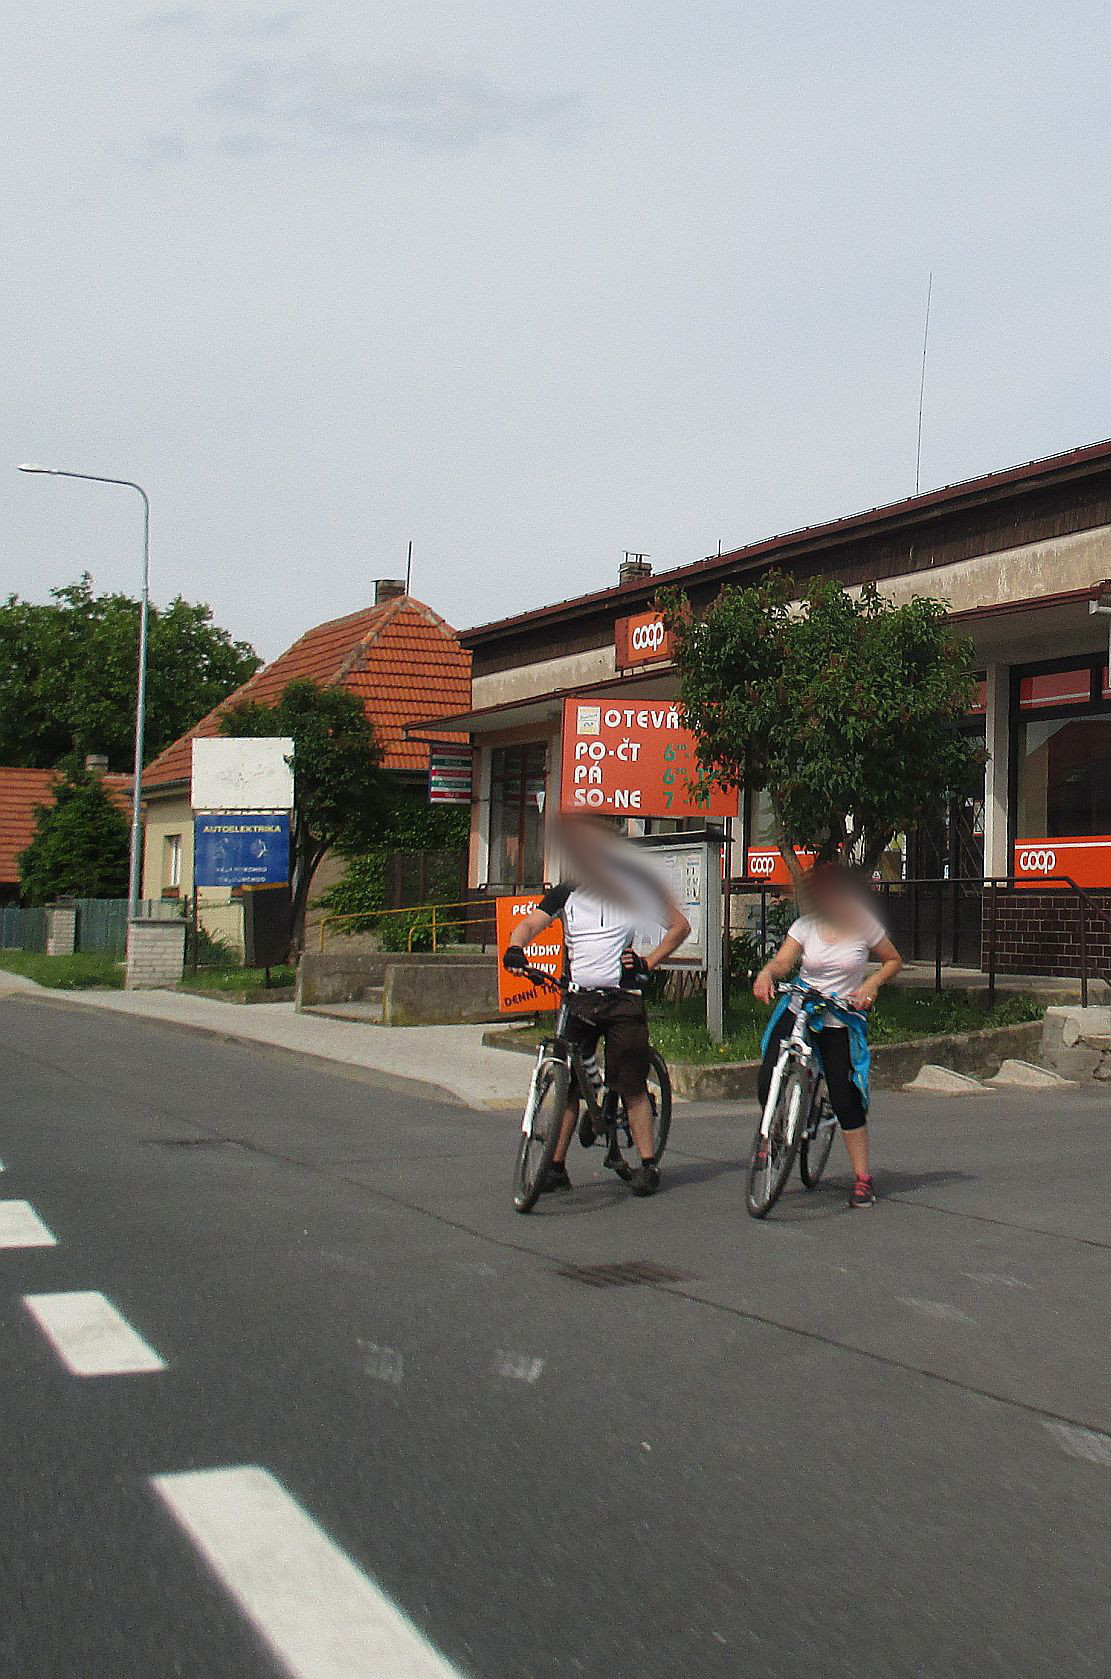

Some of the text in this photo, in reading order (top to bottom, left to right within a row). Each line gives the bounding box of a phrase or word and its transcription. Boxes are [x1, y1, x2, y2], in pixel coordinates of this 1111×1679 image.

[632, 621, 664, 652] coop
[574, 737, 641, 762] PO-ČT
[573, 761, 602, 784] PÁ
[573, 788, 641, 809] SO-NE
[663, 791, 674, 809] 7
[750, 856, 775, 876] coop
[1019, 850, 1056, 874] coop
[505, 989, 537, 1006] DENNÍ
